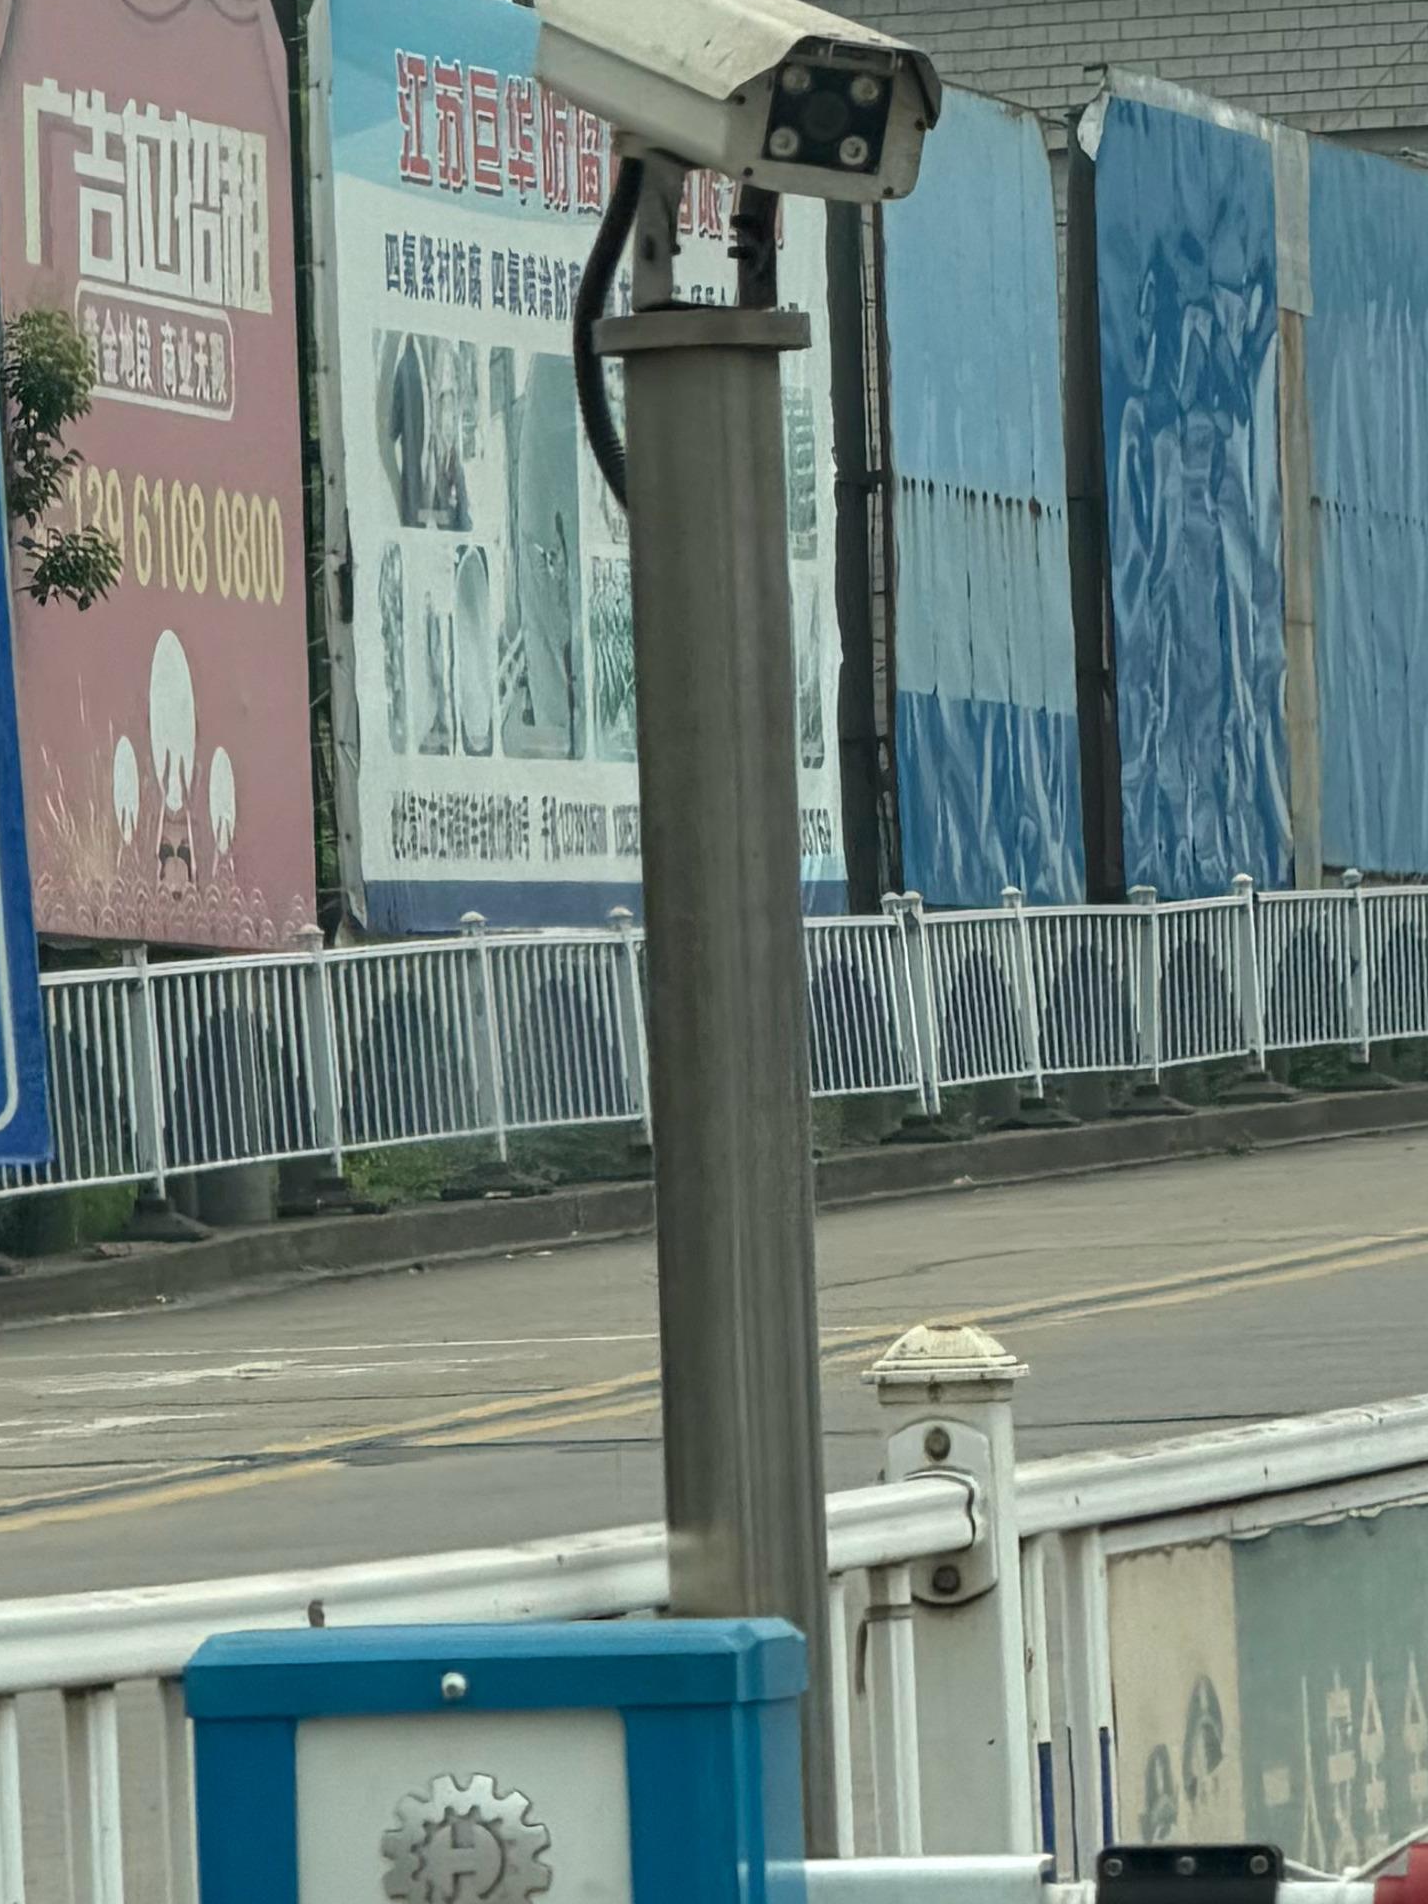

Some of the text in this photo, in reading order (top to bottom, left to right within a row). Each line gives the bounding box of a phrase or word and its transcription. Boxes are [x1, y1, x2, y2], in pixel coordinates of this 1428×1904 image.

[23, 77, 272, 315] 广告位招租
[133, 473, 209, 595] 6108
[214, 486, 285, 607] 0800
